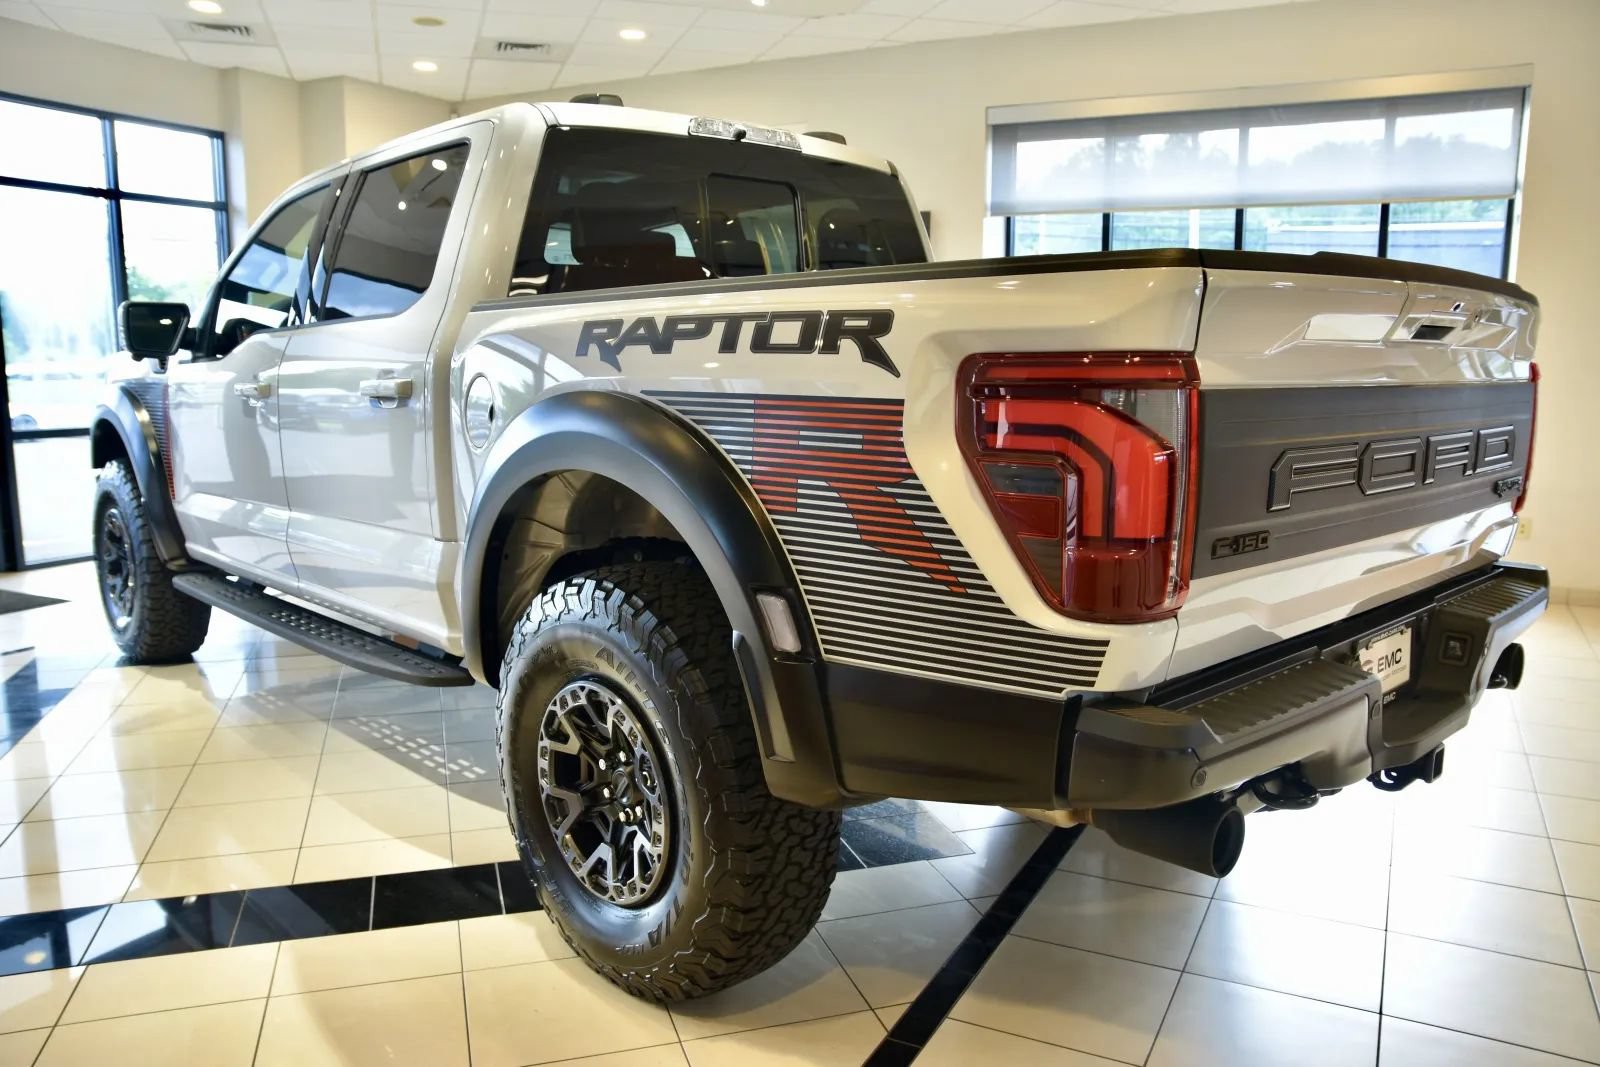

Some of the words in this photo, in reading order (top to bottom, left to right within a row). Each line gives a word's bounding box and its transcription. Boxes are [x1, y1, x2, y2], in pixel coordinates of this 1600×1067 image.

[575, 309, 900, 378] RAPTOR
[1266, 424, 1516, 513] FORD
[1211, 530, 1271, 560] F-150
[1377, 648, 1402, 674] EMC
[648, 895, 685, 949] T/A
